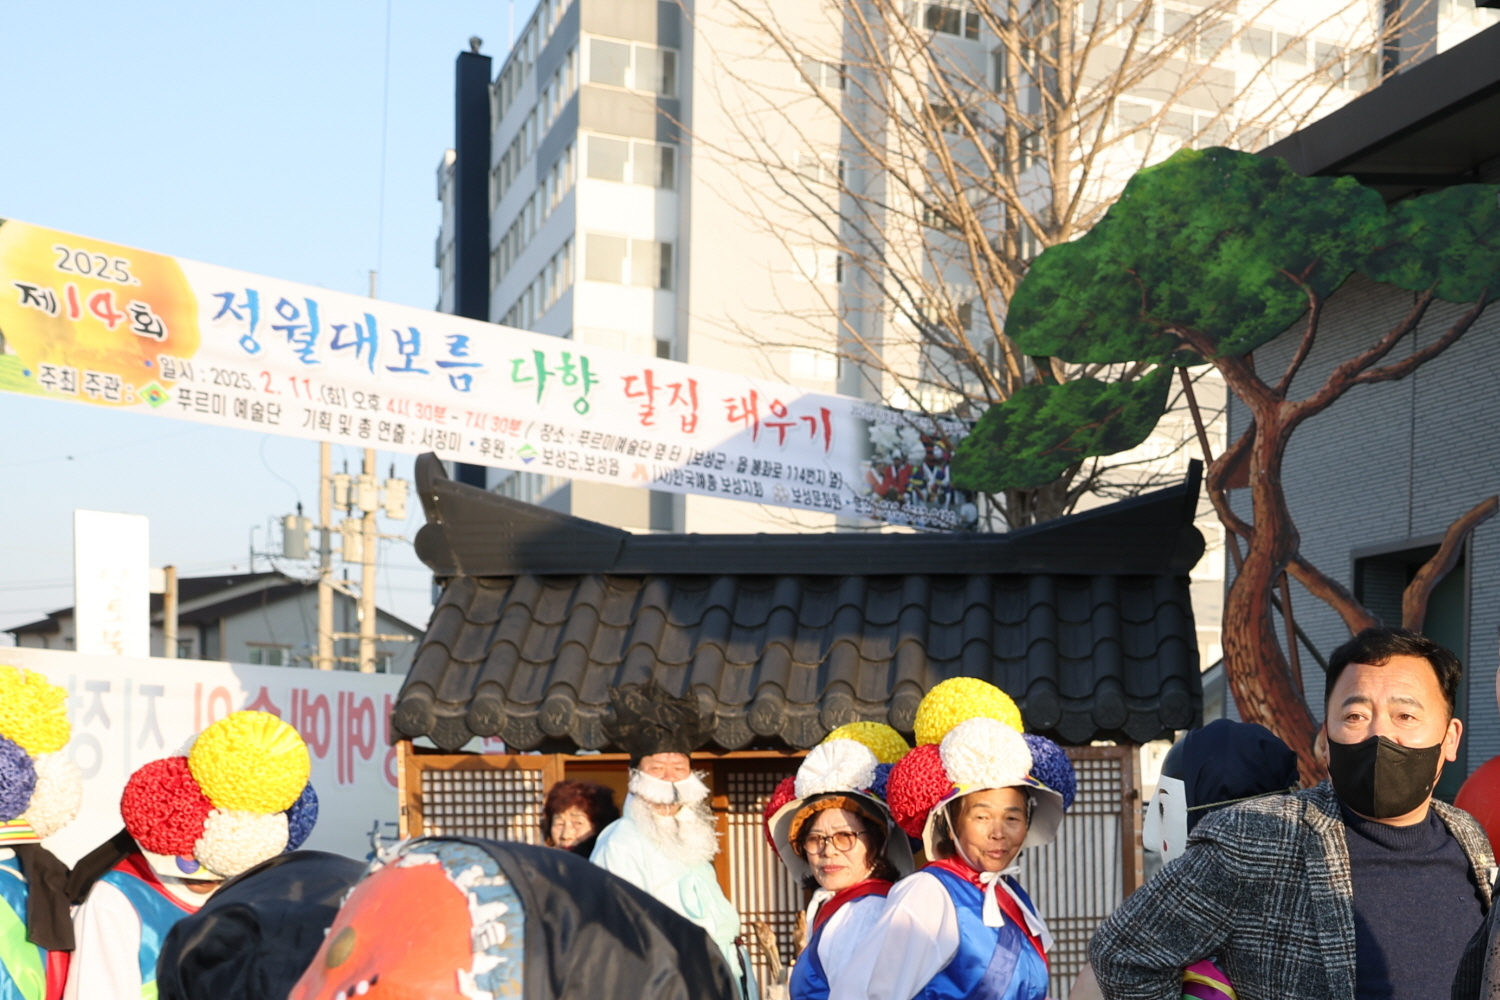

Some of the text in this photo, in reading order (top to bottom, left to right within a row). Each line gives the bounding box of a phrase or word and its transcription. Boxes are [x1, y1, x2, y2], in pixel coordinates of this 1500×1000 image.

[53, 247, 139, 286] 2025.
[15, 282, 164, 340] 제14회
[213, 289, 484, 392] 정월대보름
[510, 350, 598, 415] 다향
[621, 369, 698, 434] 달집
[725, 390, 832, 453] 태우기
[40, 364, 76, 393] 주최
[177, 387, 227, 417] 푸르미
[233, 397, 282, 425] 예술단
[302, 408, 333, 433] 기획
[420, 428, 462, 452] 서정미
[353, 391, 381, 412] 오후
